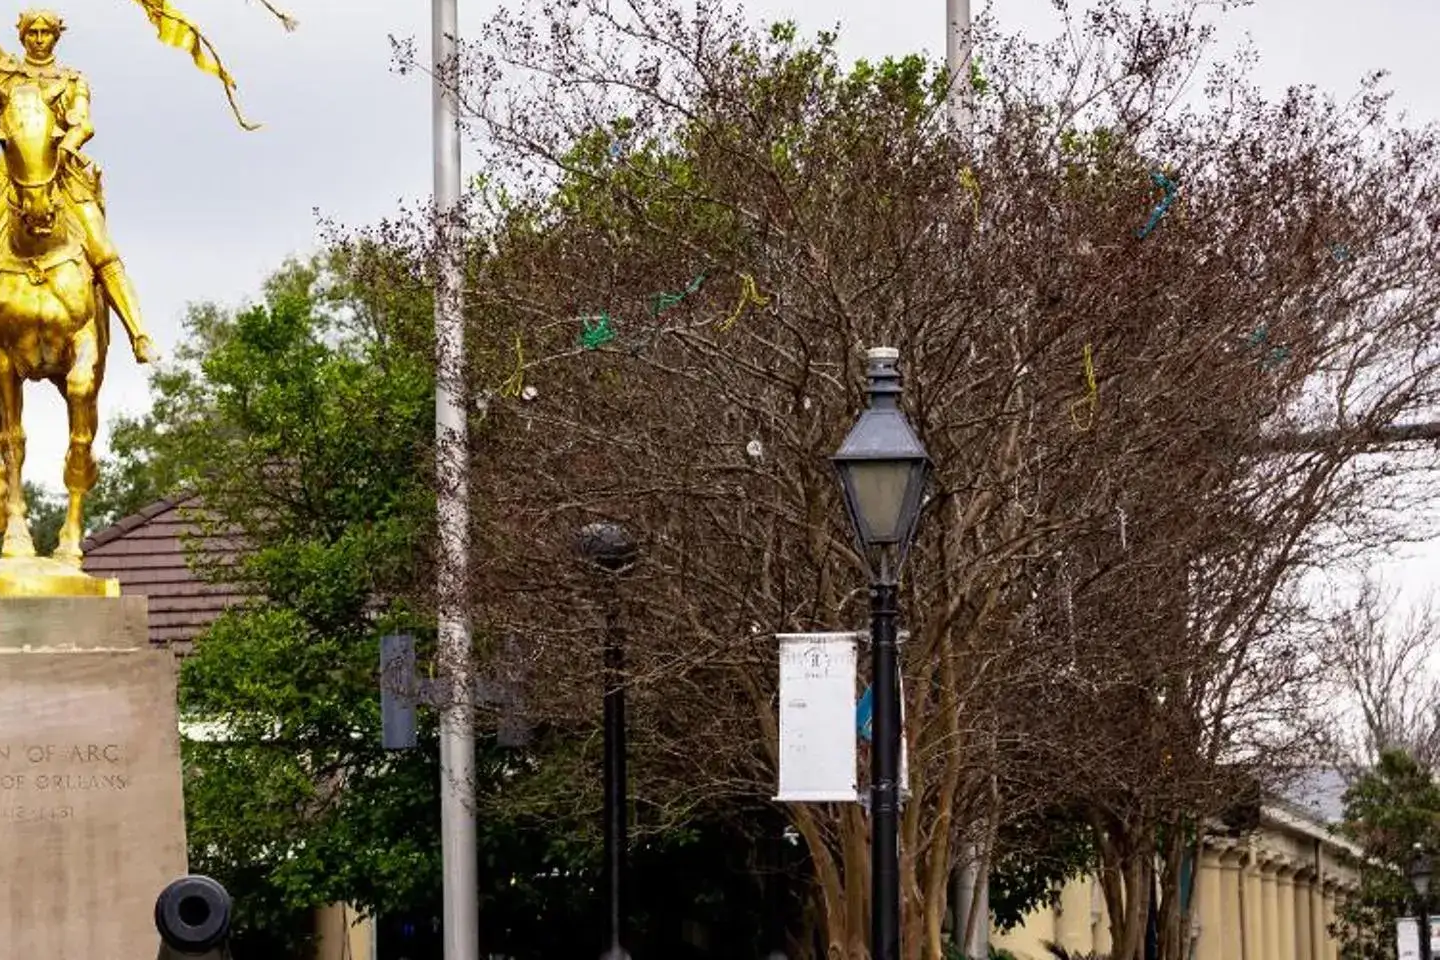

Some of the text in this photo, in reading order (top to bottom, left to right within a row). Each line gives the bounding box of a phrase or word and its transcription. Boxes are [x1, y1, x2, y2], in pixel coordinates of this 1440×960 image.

[26, 744, 57, 763] OF
[71, 744, 120, 764] ARC
[0, 775, 26, 790] OF
[35, 774, 130, 791] ORLEANS
